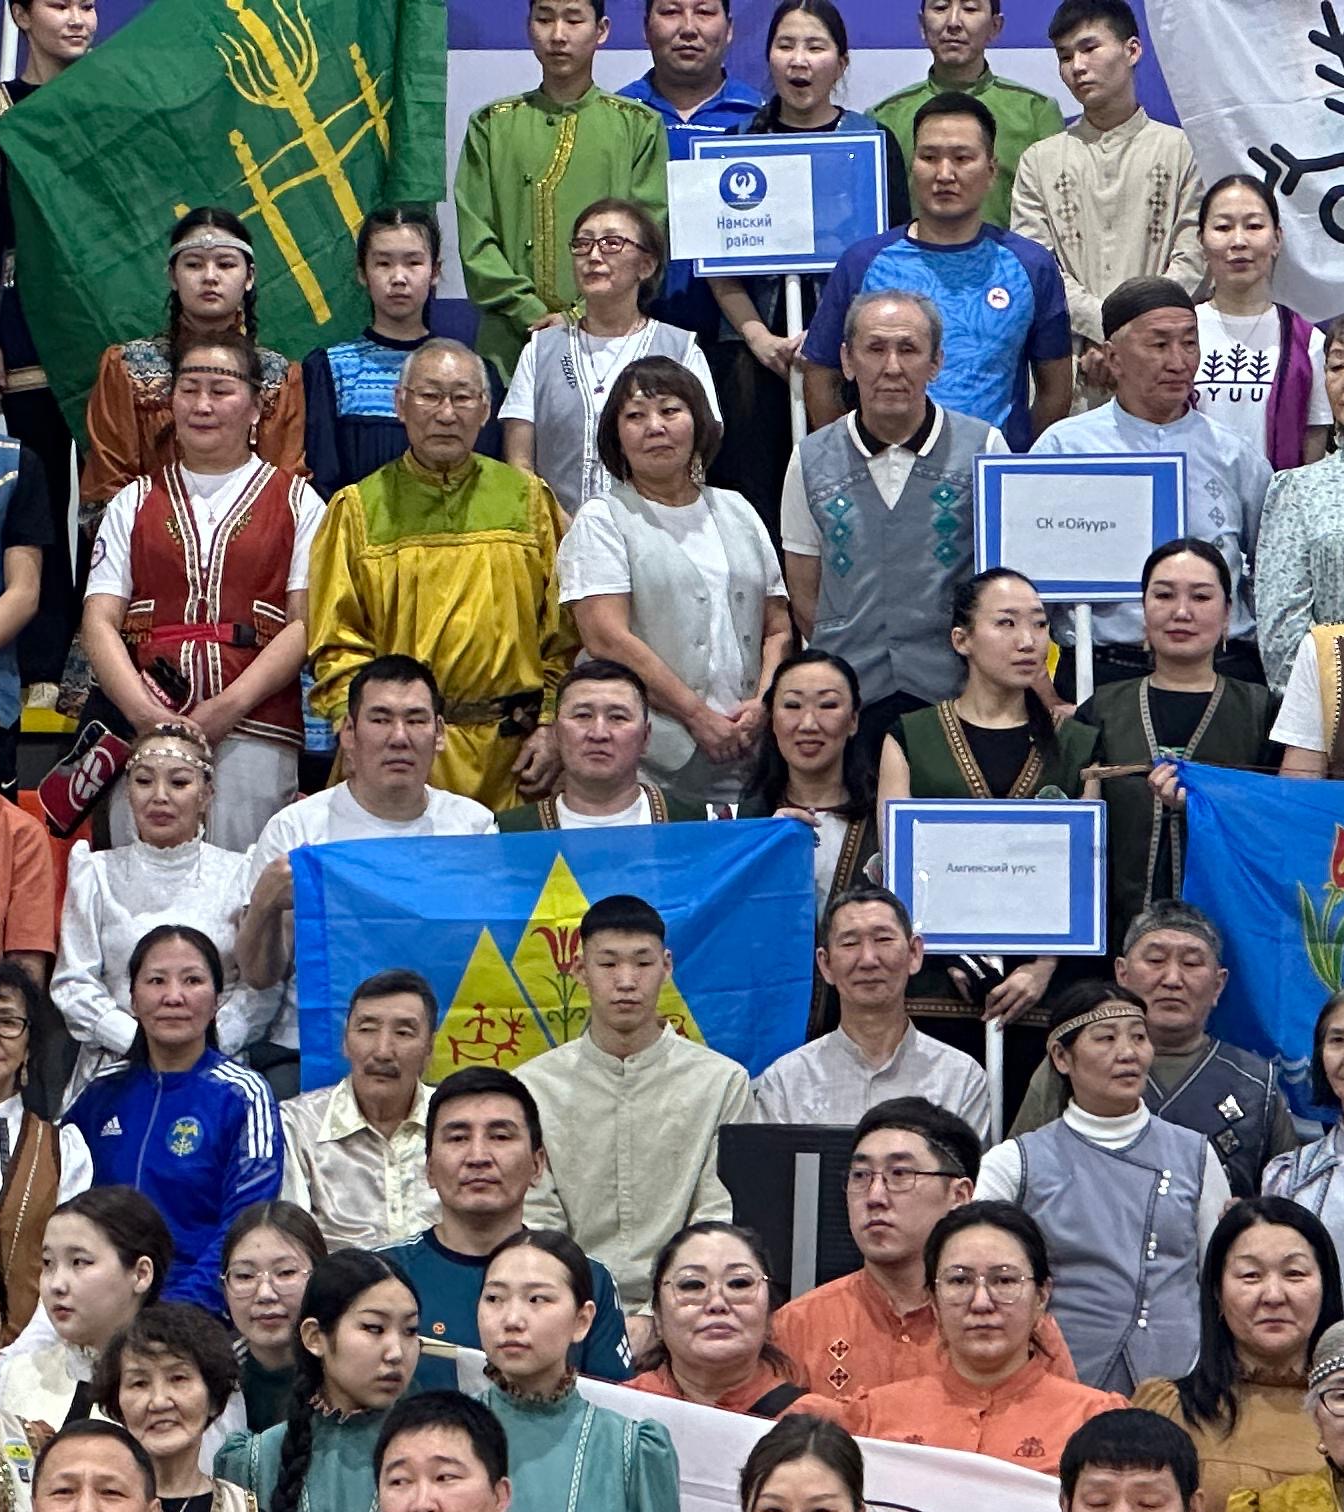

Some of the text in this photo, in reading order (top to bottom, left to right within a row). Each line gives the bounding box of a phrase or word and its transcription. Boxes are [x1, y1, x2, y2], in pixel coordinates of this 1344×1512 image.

[717, 213, 772, 230] Намский
[726, 233, 765, 250] район
[1036, 517, 1117, 533] СК «Ойуур»
[946, 862, 1037, 875] Амгинский улус
